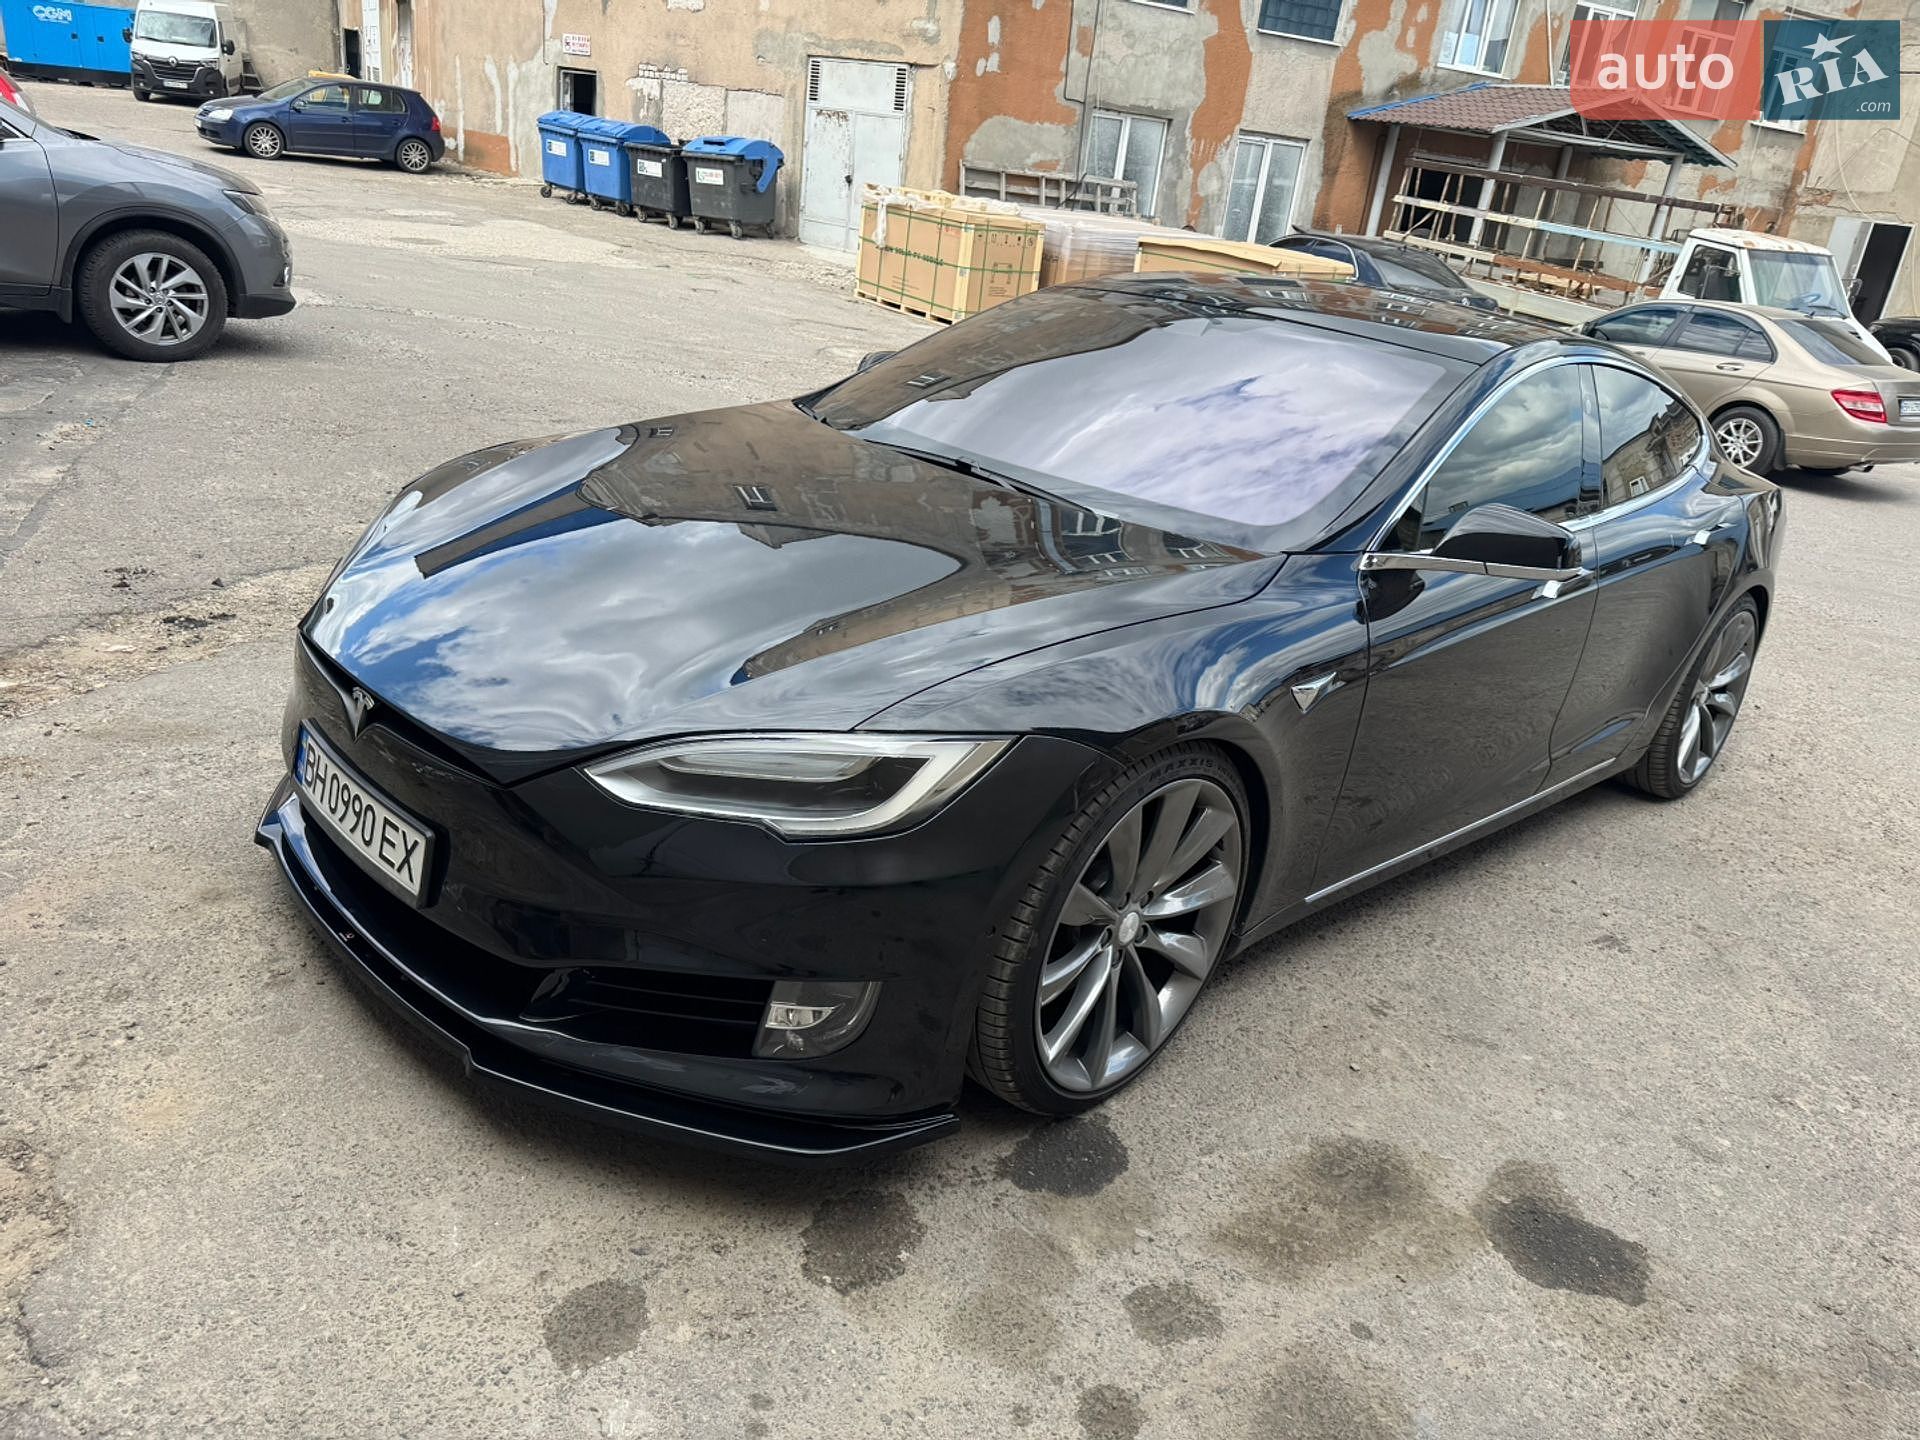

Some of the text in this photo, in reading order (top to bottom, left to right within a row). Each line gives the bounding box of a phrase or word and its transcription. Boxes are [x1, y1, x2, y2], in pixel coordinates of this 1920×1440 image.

[305, 743, 419, 884] BH 0990 EX
